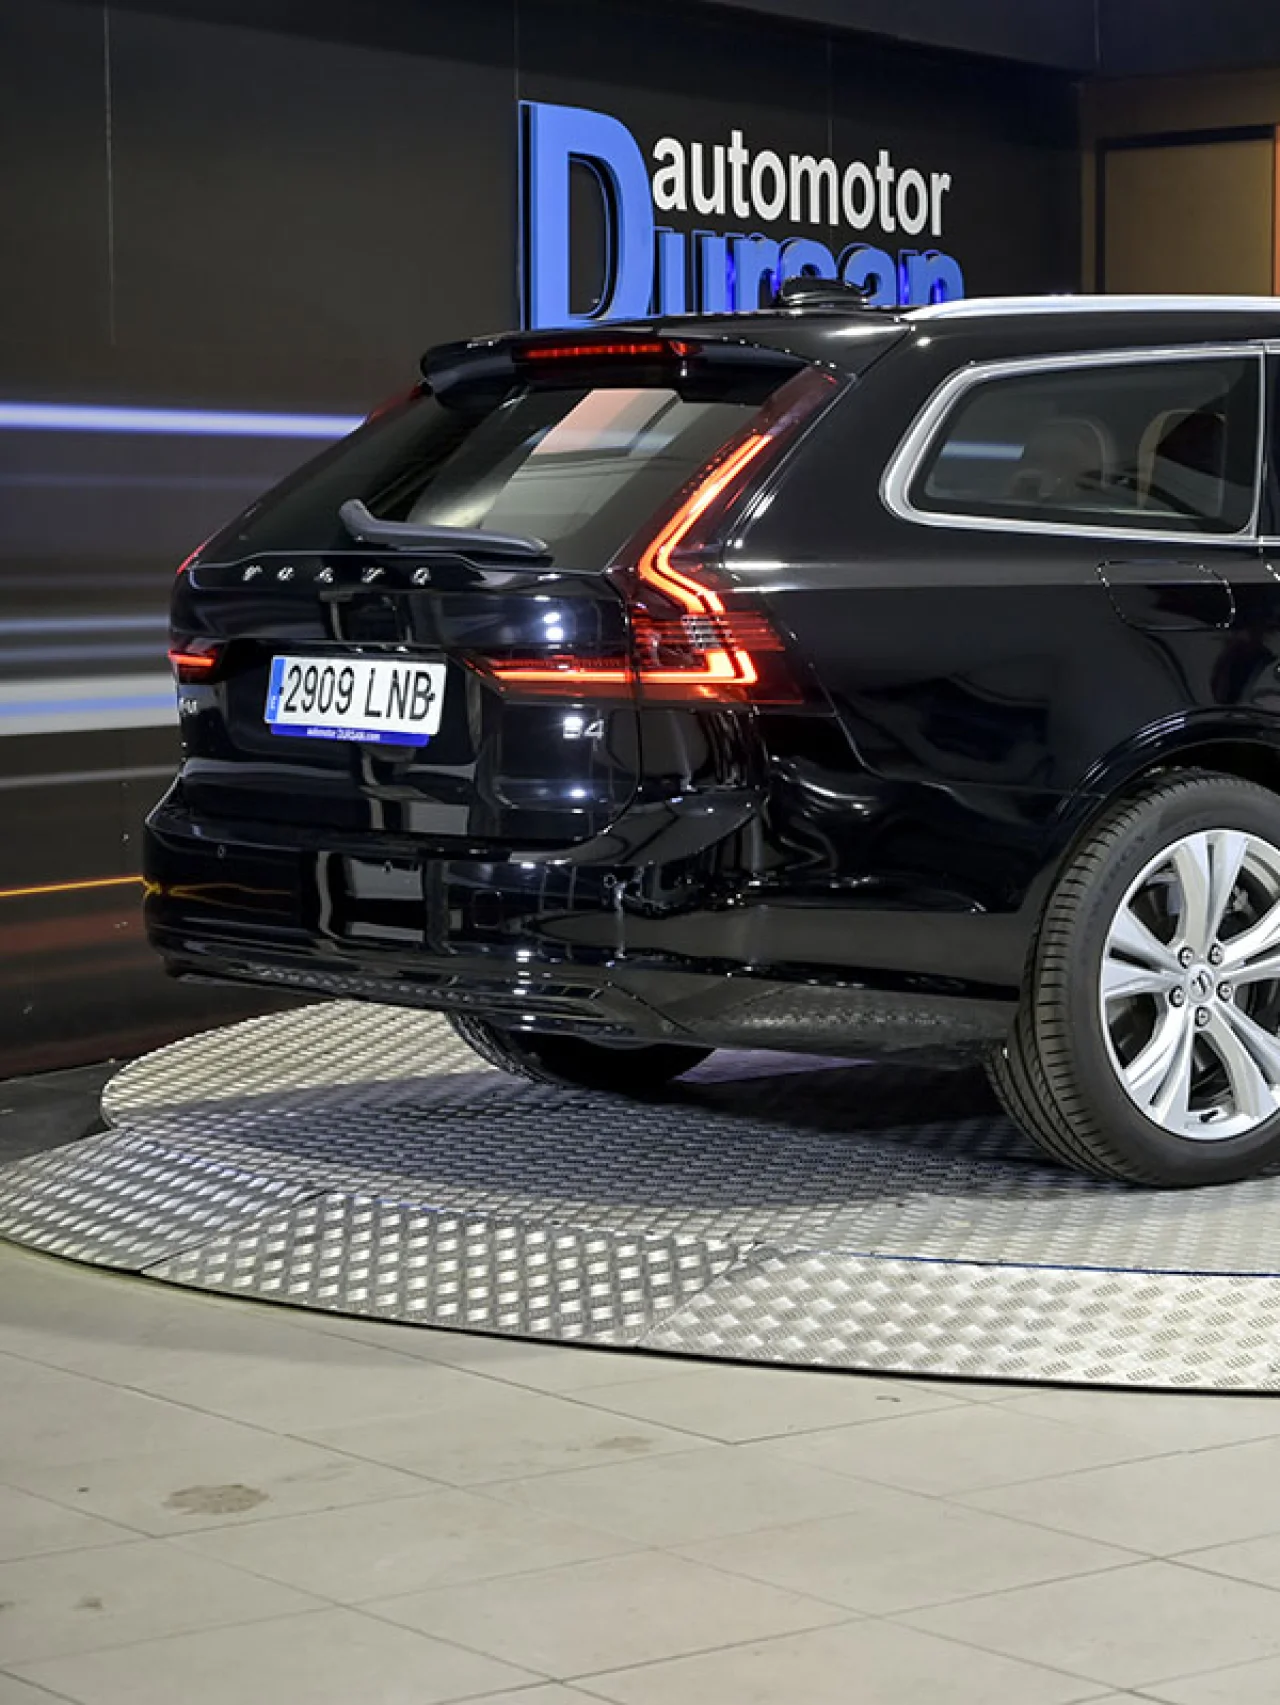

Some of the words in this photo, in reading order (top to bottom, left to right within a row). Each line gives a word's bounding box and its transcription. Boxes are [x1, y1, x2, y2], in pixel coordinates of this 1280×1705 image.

[651, 129, 952, 236] automotor
[283, 664, 355, 715] 2909
[364, 667, 429, 721] LNB
